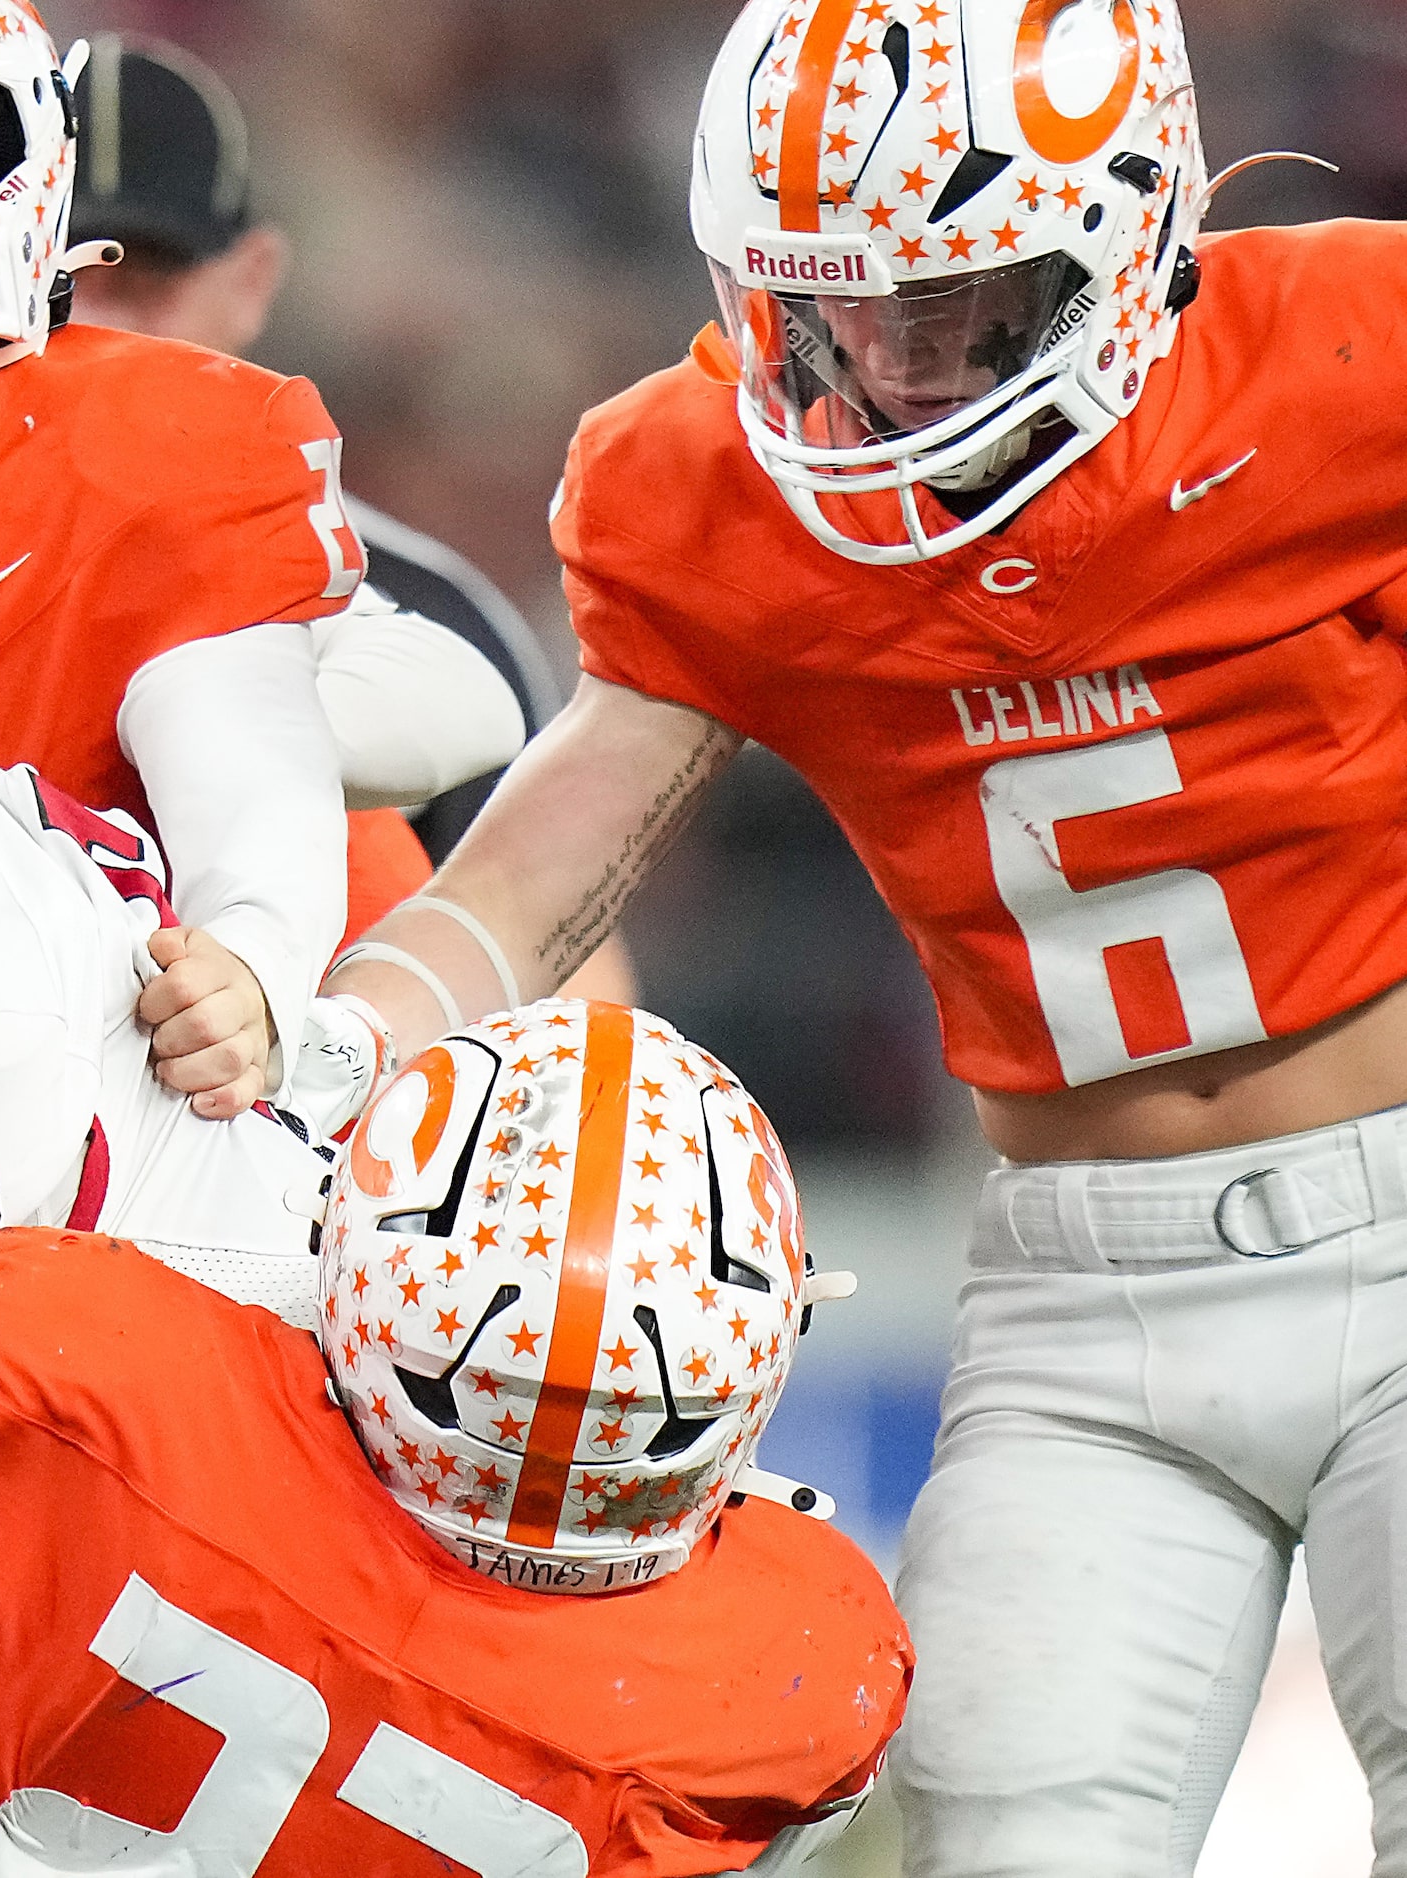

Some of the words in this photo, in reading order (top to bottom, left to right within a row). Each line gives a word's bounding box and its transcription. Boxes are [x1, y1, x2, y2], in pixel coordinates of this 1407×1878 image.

[745, 247, 866, 281] Riddell
[951, 664, 1163, 747] CELINA
[979, 728, 1269, 1087] 6
[456, 1537, 586, 1586] JAMES
[604, 1554, 660, 1587] 1:19
